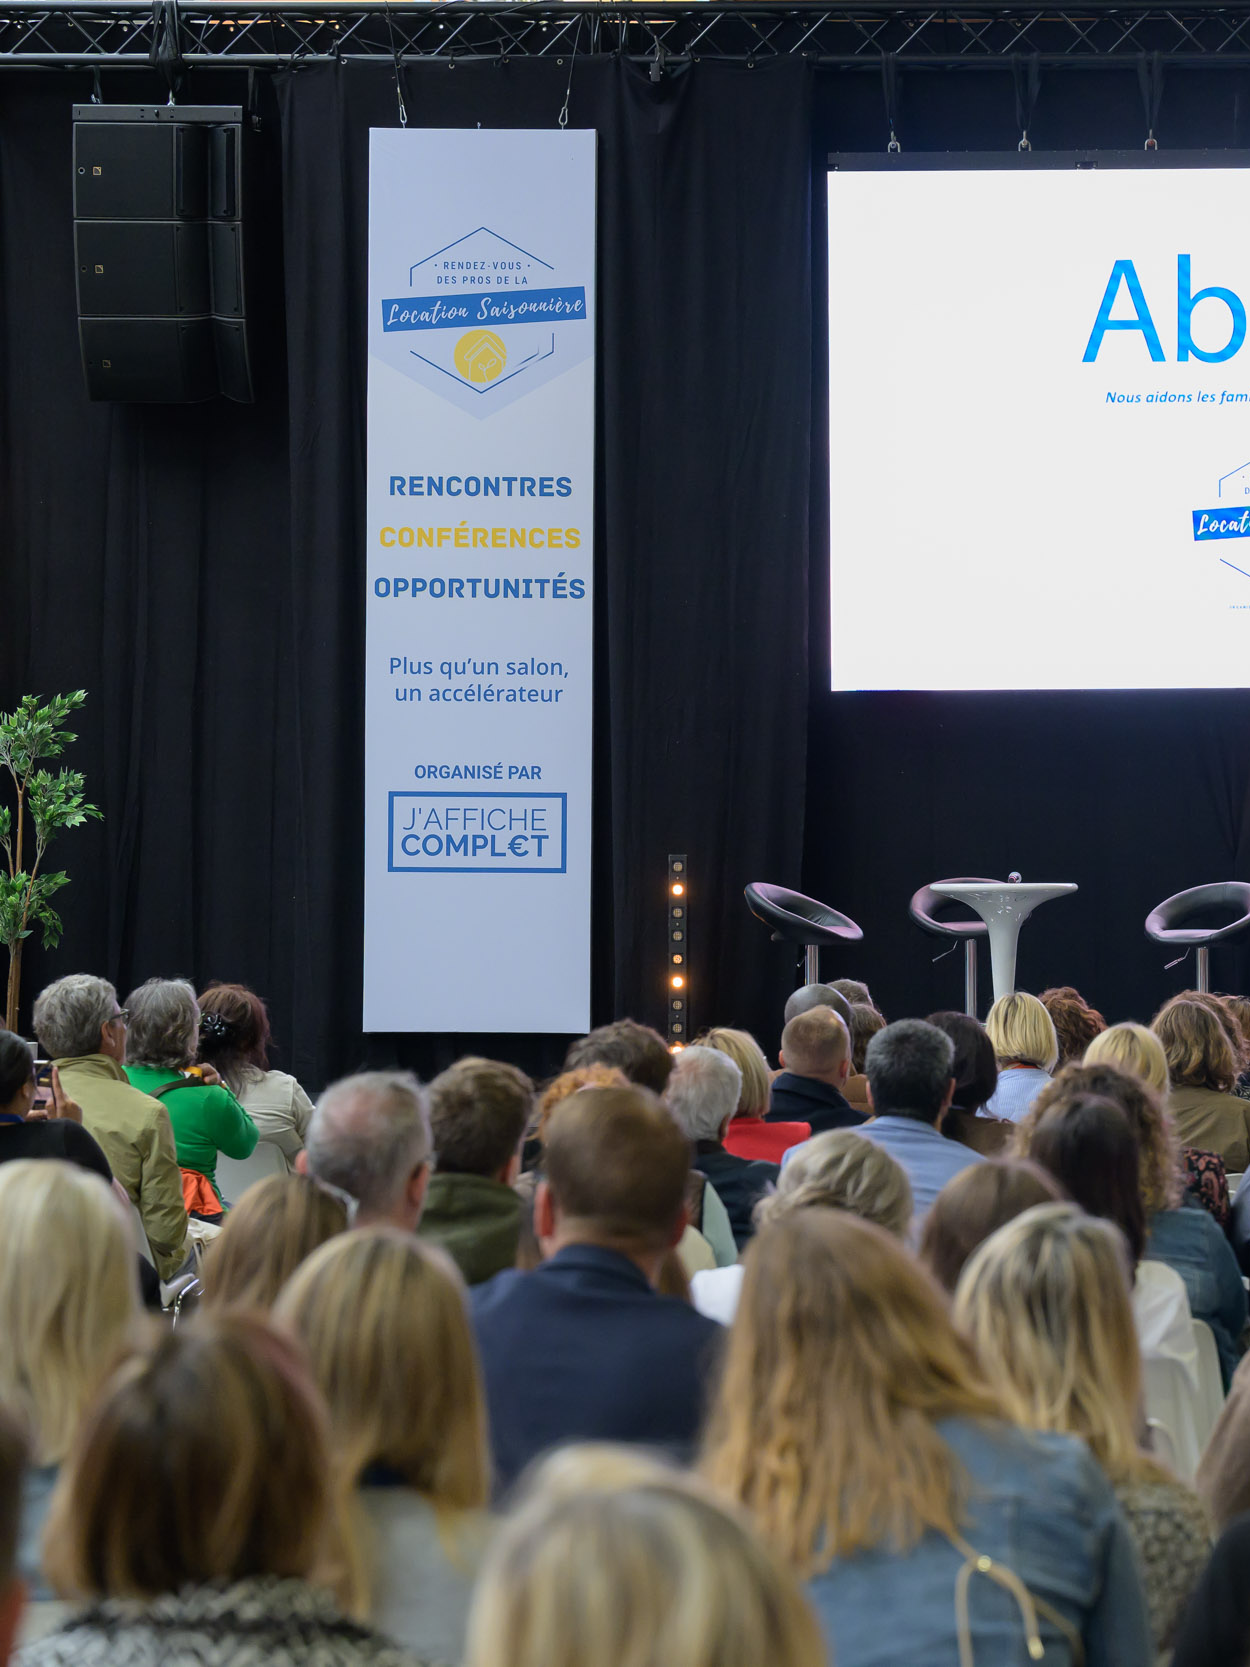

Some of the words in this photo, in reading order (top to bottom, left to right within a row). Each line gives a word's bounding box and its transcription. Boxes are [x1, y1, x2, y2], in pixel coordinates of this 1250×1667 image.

[443, 261, 522, 270] RENDEZ-VOUS
[436, 276, 457, 284] DES
[462, 276, 491, 284] PROS
[496, 276, 510, 284] DE
[514, 276, 528, 285] LA
[386, 300, 469, 326] Location
[476, 297, 584, 320] Saisonnière
[1106, 392, 1142, 404] Nous
[1146, 391, 1192, 403] aidons
[1197, 390, 1216, 402] les
[389, 476, 572, 498] RENCONTRES
[379, 520, 582, 548] CONFÉRENCES
[374, 572, 586, 600] OPPORTUNITÉS
[390, 656, 433, 676] Plus
[506, 658, 569, 678] salon,
[395, 688, 422, 702] un
[428, 684, 564, 703] accélérateur
[414, 762, 504, 780] ORGANISÉ
[508, 766, 542, 780] PAR
[402, 808, 547, 831] J'AFFICHE
